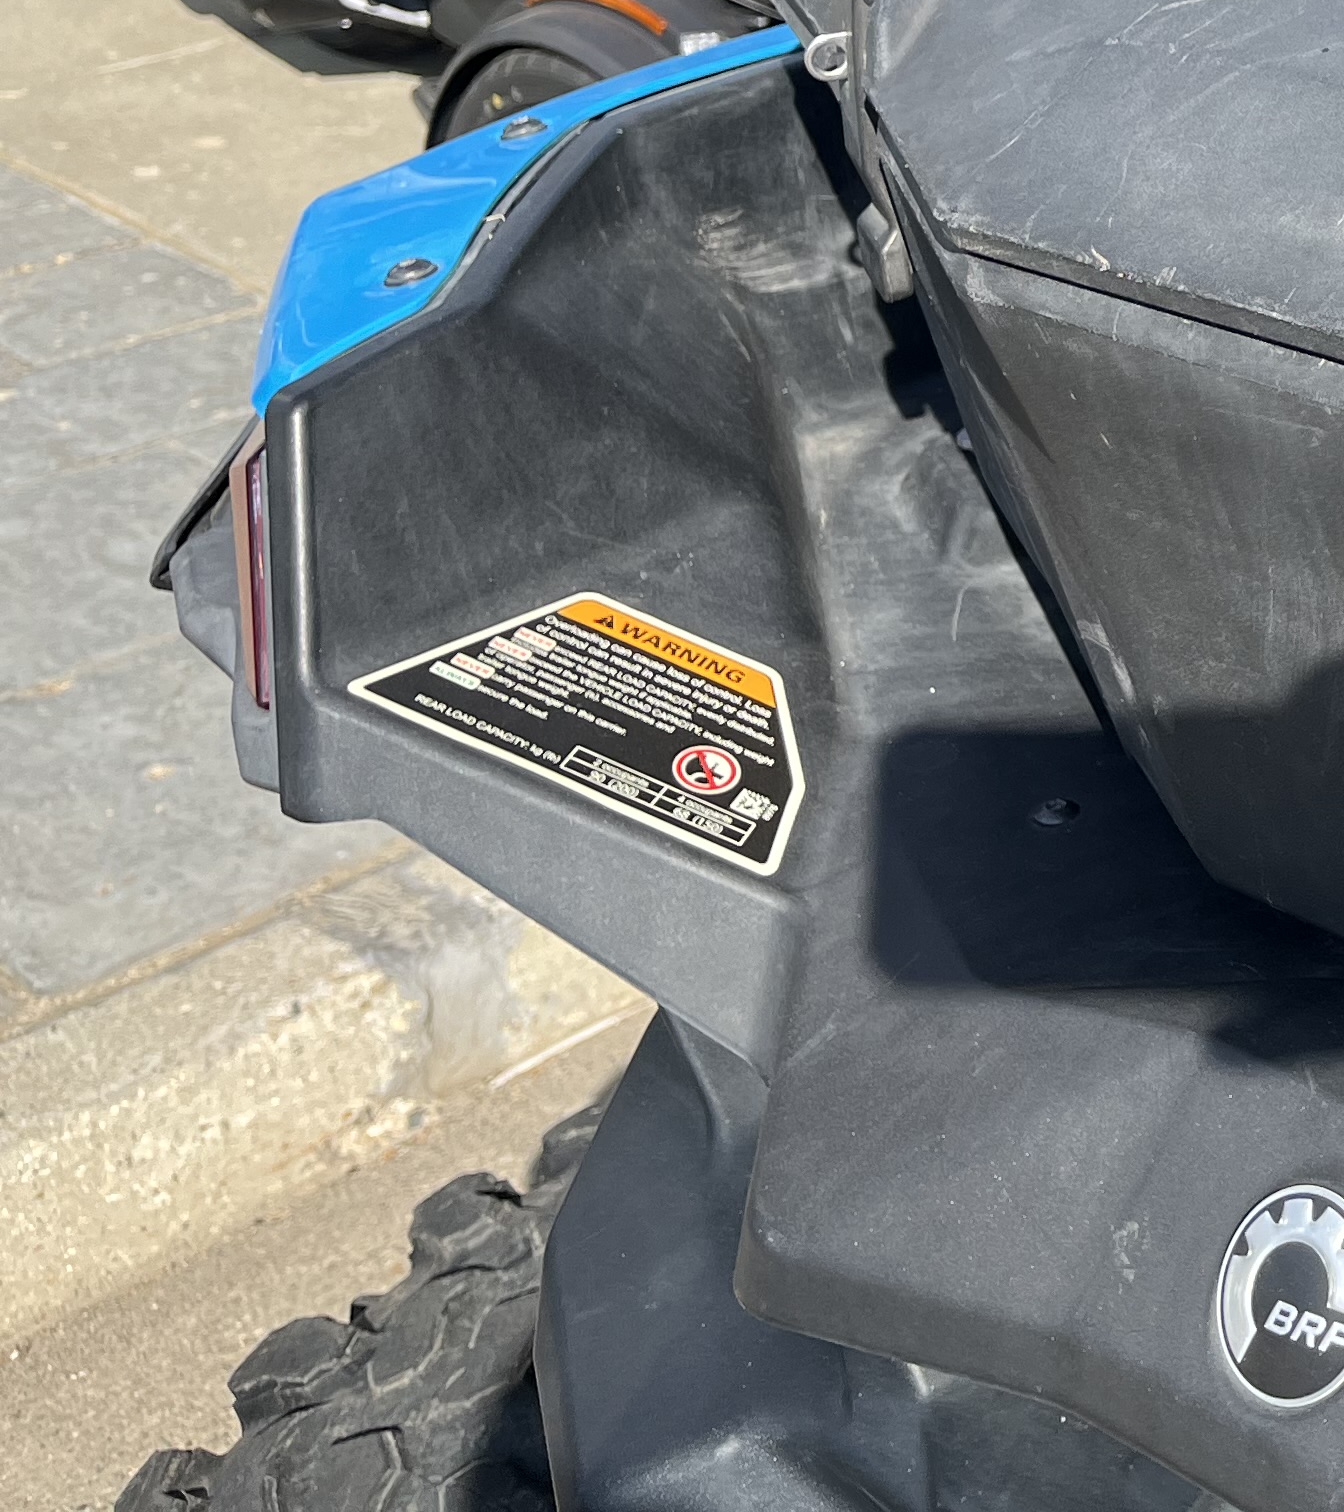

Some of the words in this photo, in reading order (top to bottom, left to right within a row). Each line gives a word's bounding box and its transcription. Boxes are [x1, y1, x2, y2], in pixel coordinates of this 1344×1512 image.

[546, 615, 610, 648] Overloading
[612, 644, 632, 657] can
[634, 653, 666, 672] cause
[668, 666, 690, 682] loss
[705, 684, 743, 706] control.
[745, 700, 771, 718] Loss
[621, 623, 745, 683] WARNING
[551, 632, 589, 650] control
[588, 646, 609, 660] can
[611, 655, 642, 674] result
[655, 675, 691, 695] severe
[737, 710, 769, 730] death.
[588, 659, 617, 677] REAR
[618, 671, 646, 689] LOAD
[510, 697, 525, 709] the
[560, 670, 578, 685] the
[620, 695, 651, 716] LOAD
[416, 694, 446, 713] REAR
[446, 707, 476, 725] LOAD
[578, 710, 595, 722] this
[656, 721, 675, 733] and
